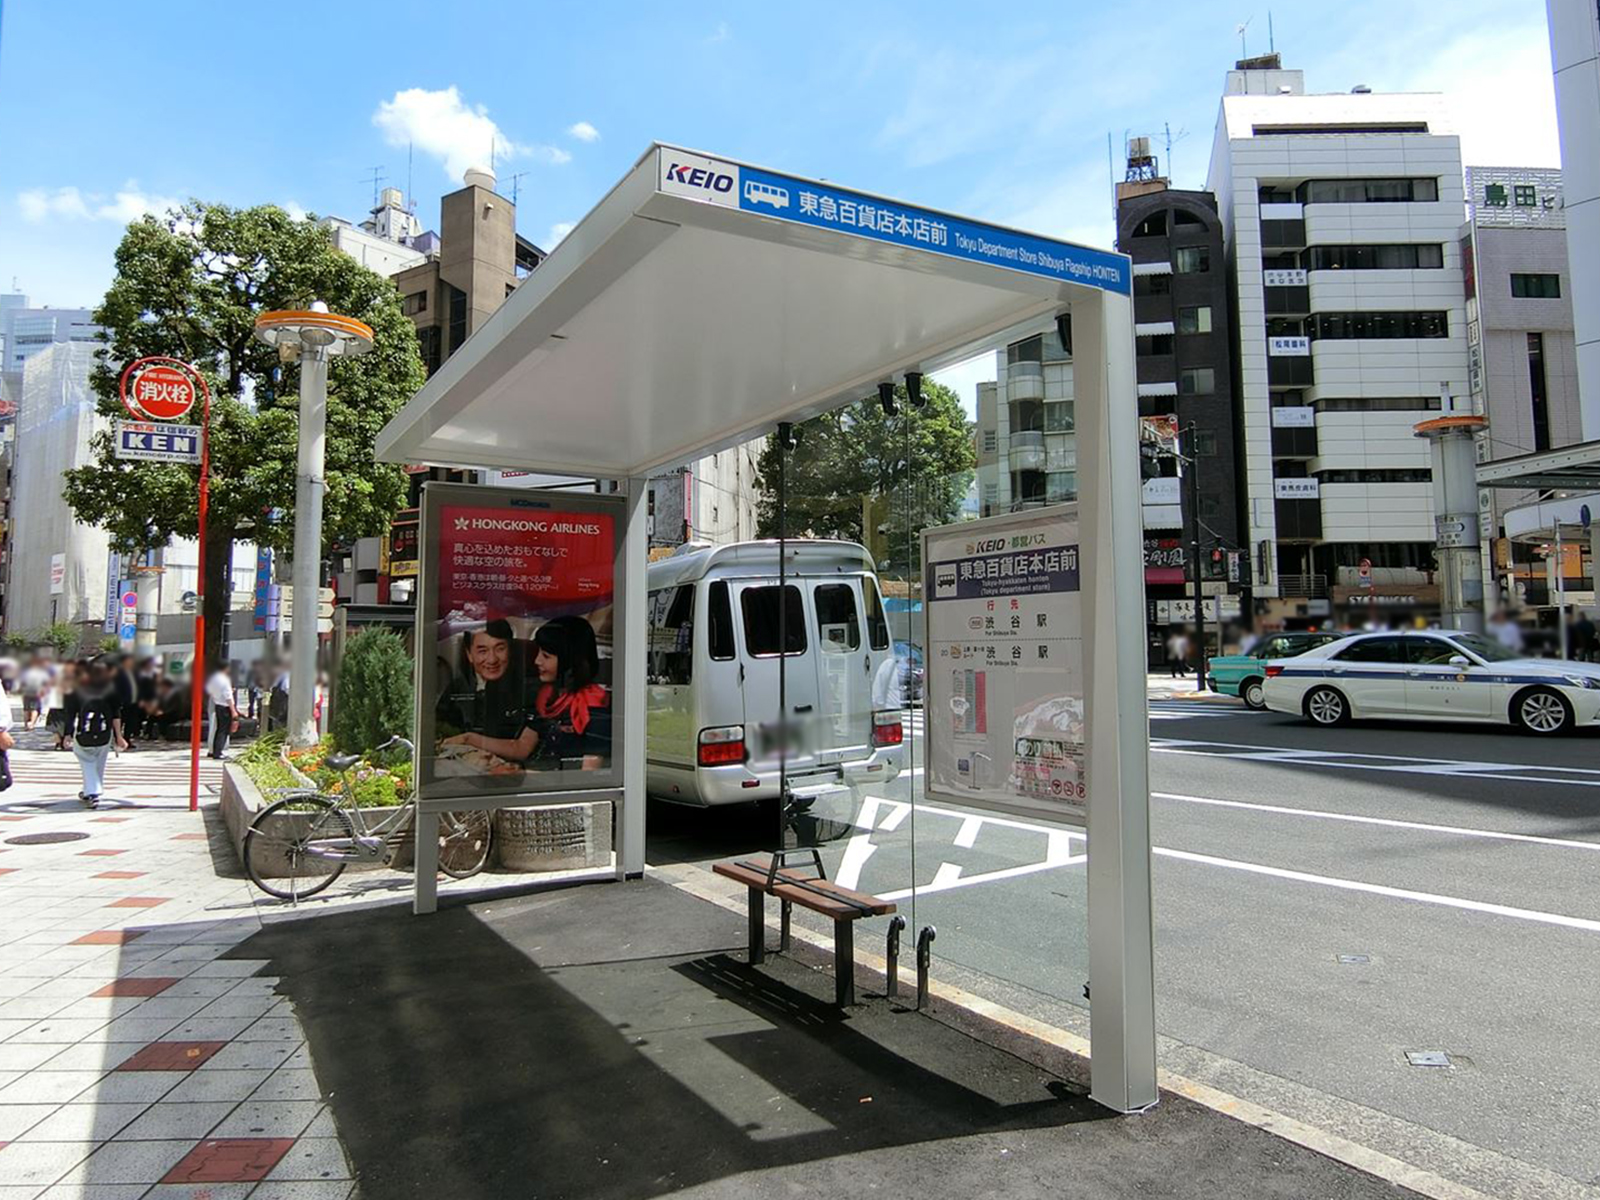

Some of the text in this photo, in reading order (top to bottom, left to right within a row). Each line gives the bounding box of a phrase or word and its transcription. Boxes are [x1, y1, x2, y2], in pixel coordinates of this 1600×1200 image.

[666, 163, 734, 193] KEIO
[799, 191, 948, 246] 東急百貨店本店前
[954, 232, 1121, 283] Tokyu Department Store Shibuya Flagship HONTEN
[139, 381, 189, 404] 消火栓
[128, 433, 190, 452] KEN
[472, 518, 600, 535] HONGKONG AIRLINES
[453, 543, 568, 557] 真心を込めたおもてなしで
[976, 538, 1006, 554] KEIO
[453, 556, 528, 568] 快適な空の旅を。
[960, 550, 1077, 580] 東急百貨店本店前
[980, 583, 1050, 596] (Tokyu department store)
[982, 576, 1027, 587] Tokyu-hyakkaten
[107, 575, 117, 629] intimissimi
[1348, 594, 1416, 605] STARBUCKS
[985, 613, 1048, 629] 渋谷駅
[986, 645, 1049, 659] 渋谷駅
